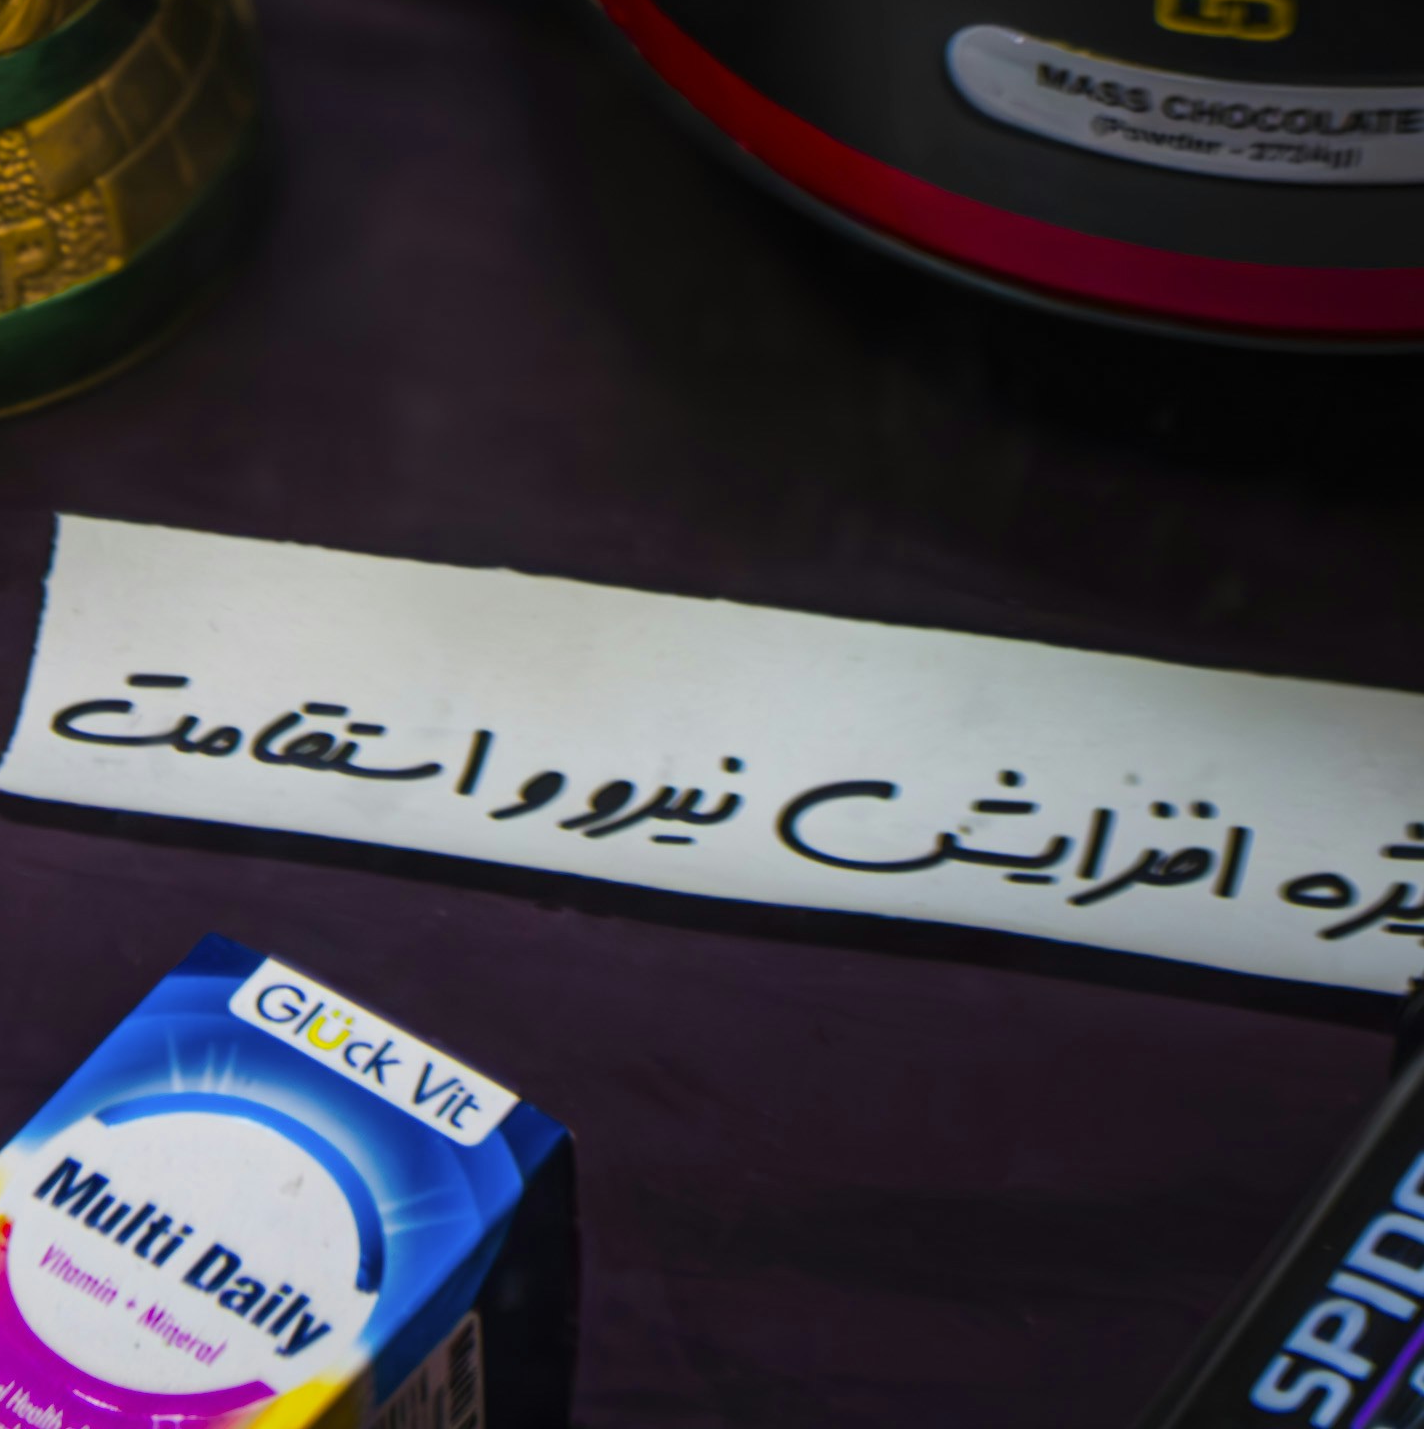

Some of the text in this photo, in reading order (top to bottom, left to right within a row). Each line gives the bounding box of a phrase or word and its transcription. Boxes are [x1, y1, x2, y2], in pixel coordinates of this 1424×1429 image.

[1035, 62, 1152, 113] MASS
[255, 983, 482, 1130] Glück Vit
[32, 1156, 333, 1359] Multi Daily
[39, 1242, 119, 1307] Vitamin
